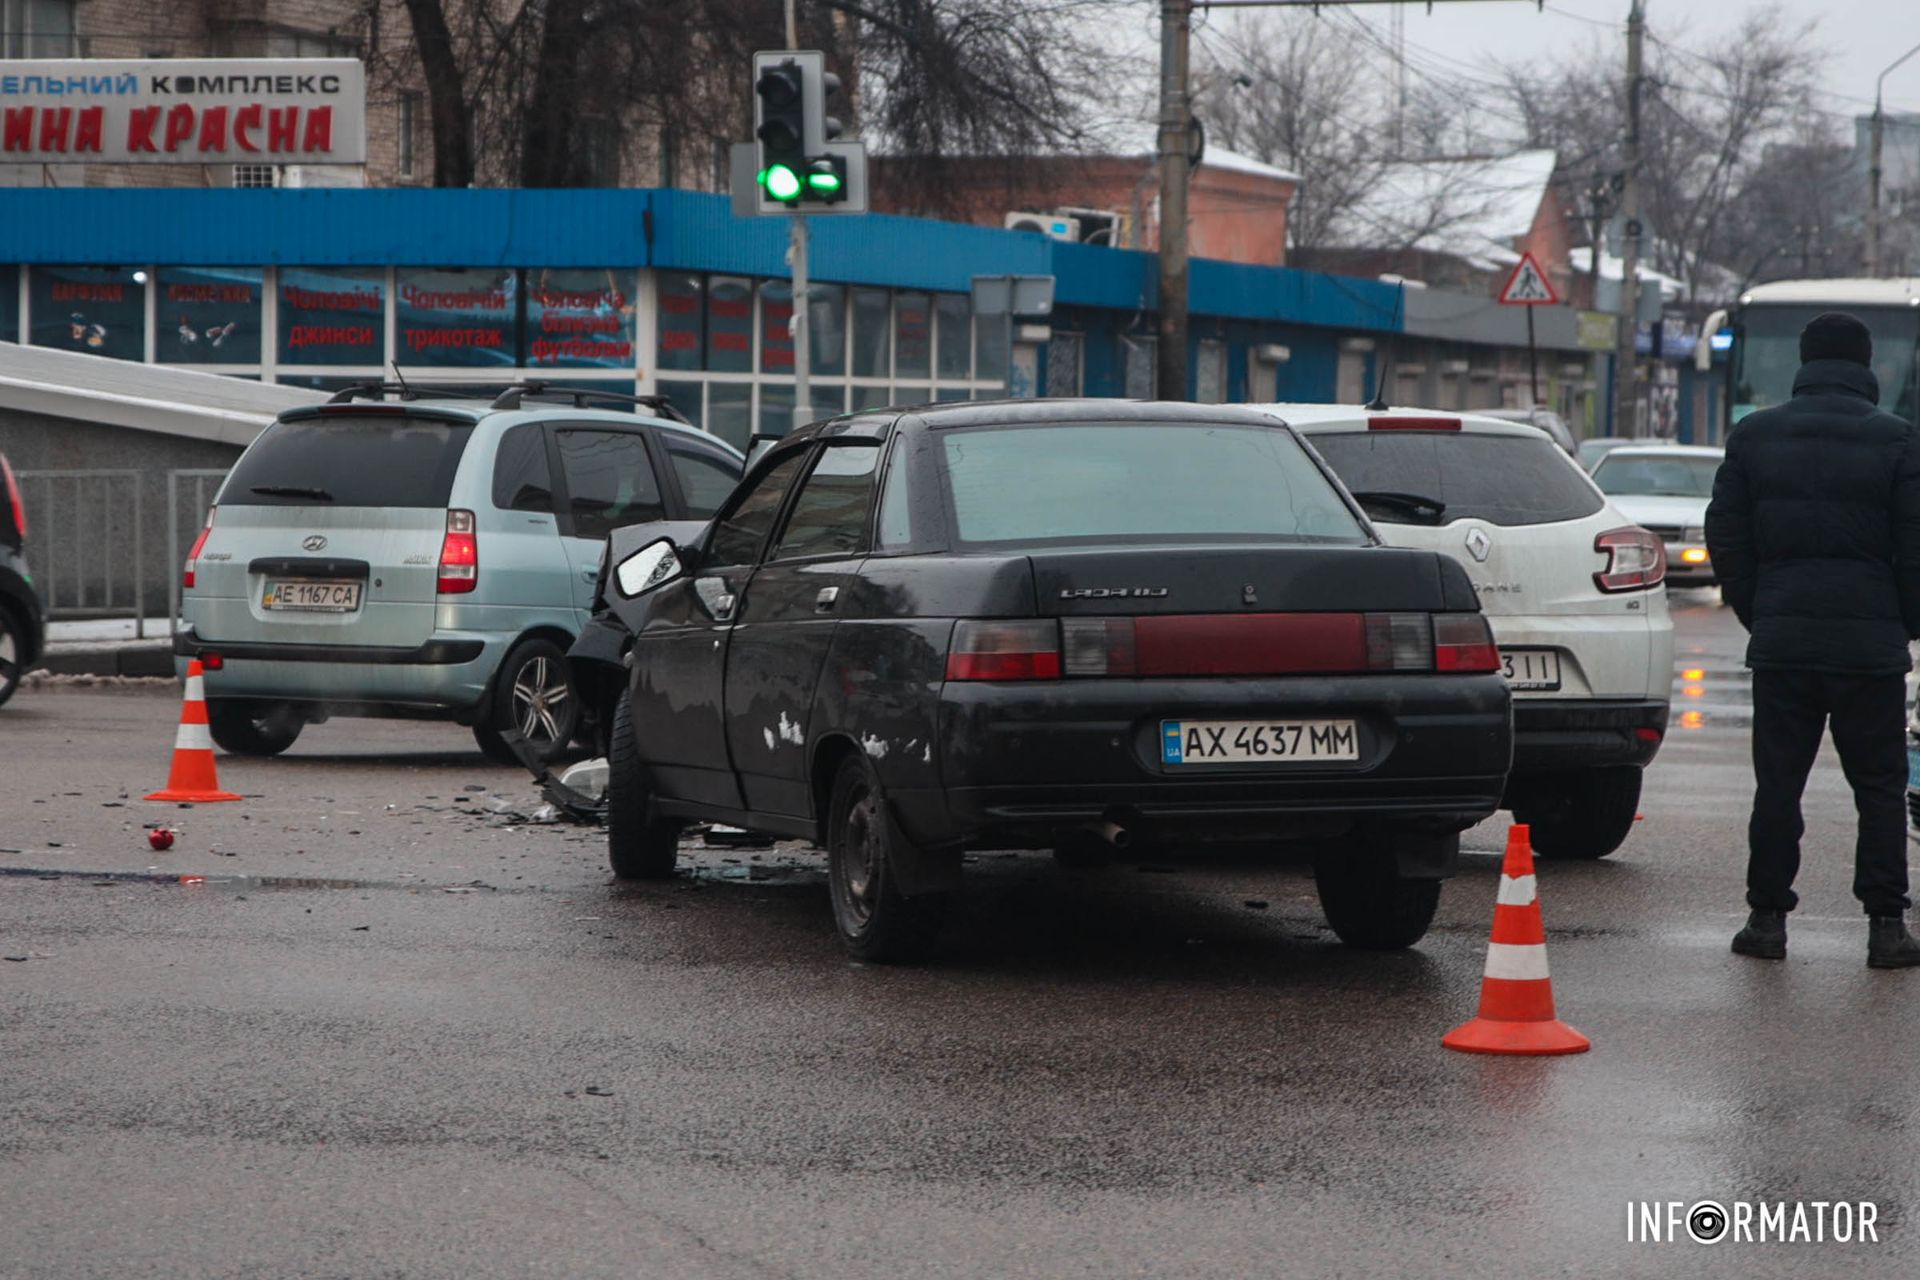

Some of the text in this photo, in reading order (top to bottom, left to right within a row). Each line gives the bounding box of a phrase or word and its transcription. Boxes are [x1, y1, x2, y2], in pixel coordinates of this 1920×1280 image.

[1, 73, 340, 95] ЕЛЬНИЙ КОМПЛЕКС
[4, 104, 334, 153] ИНА КРАСНА
[405, 330, 502, 352] трикотаж
[297, 586, 330, 604] 1167
[1185, 725, 1354, 757] AX 4637 MM
